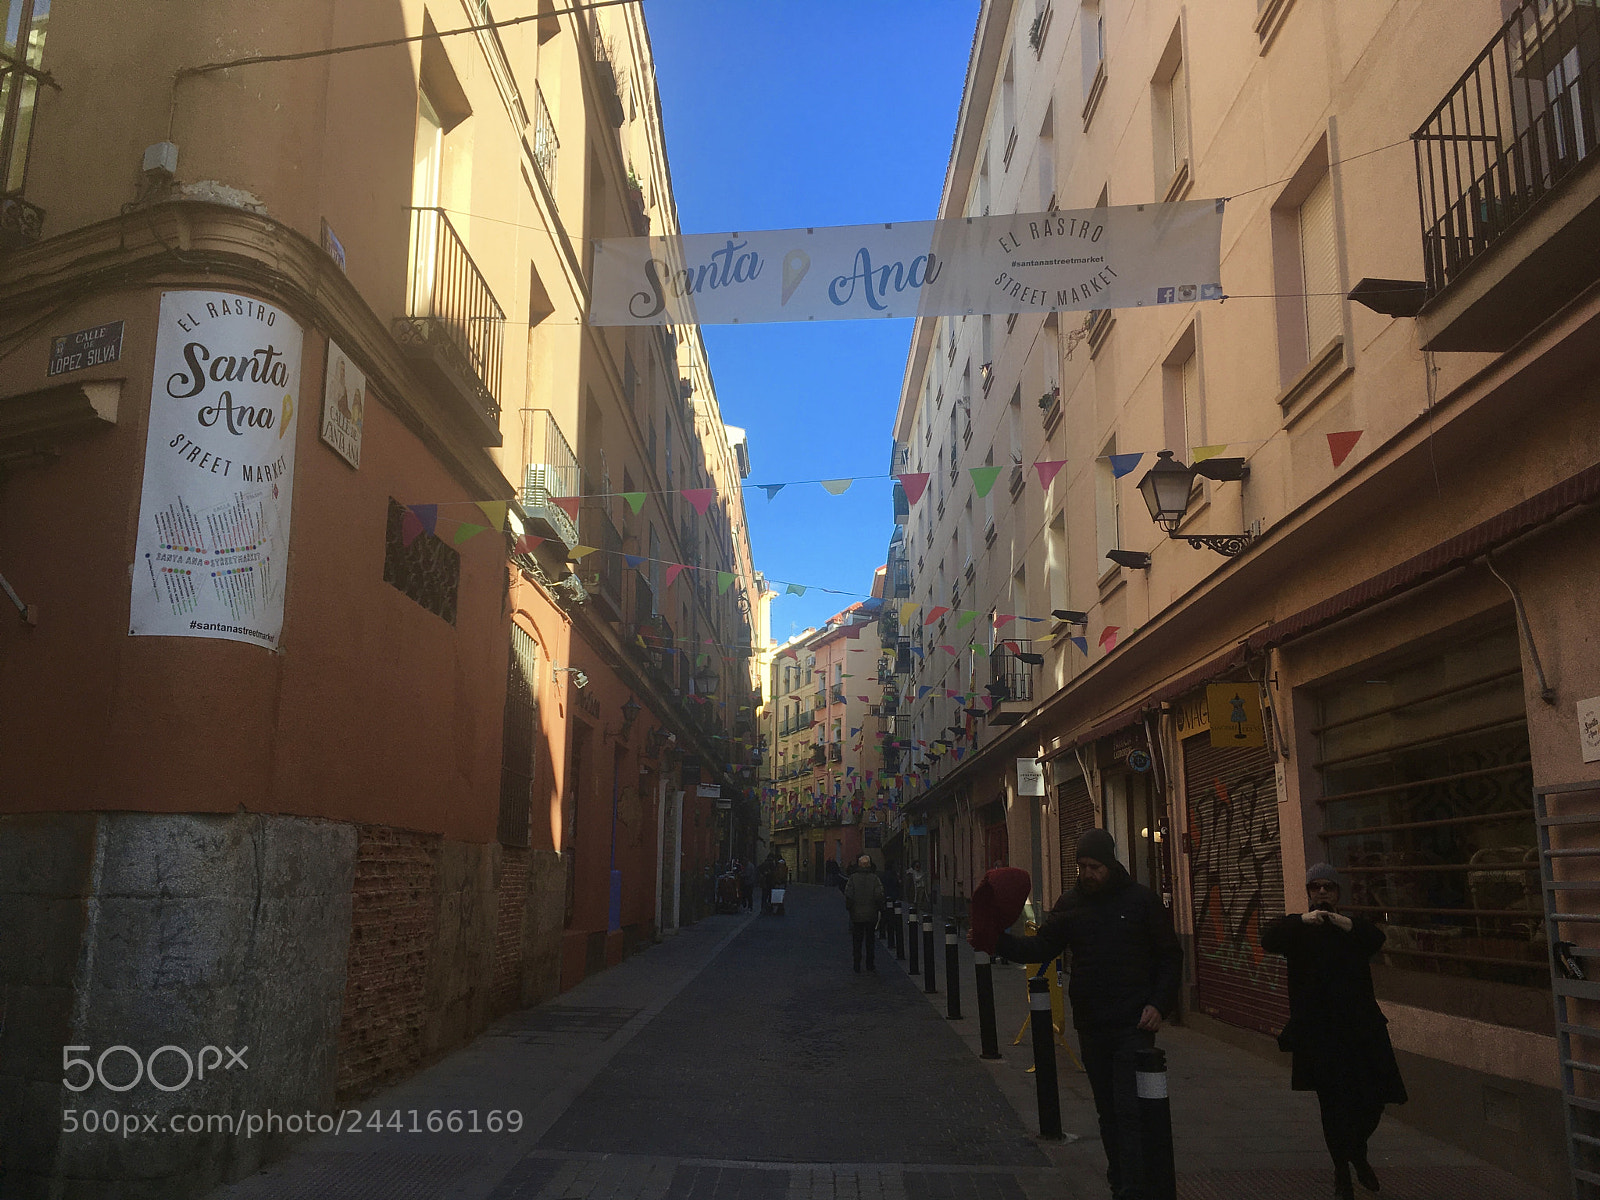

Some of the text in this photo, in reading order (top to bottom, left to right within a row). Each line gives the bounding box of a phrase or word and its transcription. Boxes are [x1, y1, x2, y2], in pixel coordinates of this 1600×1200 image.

[998, 217, 1104, 254] EL RASTRO
[628, 239, 943, 319] Santa Ana
[1011, 255, 1105, 268] #santanastreetmarket
[994, 265, 1119, 306] STREET MARKET
[177, 298, 276, 333] EL RASTRO
[75, 328, 106, 344] CALLE
[87, 345, 115, 366] SILVA
[166, 341, 290, 399] Santa
[198, 390, 275, 436] Ana
[330, 405, 352, 433] CALLE
[169, 433, 288, 482] STREET MARKET
